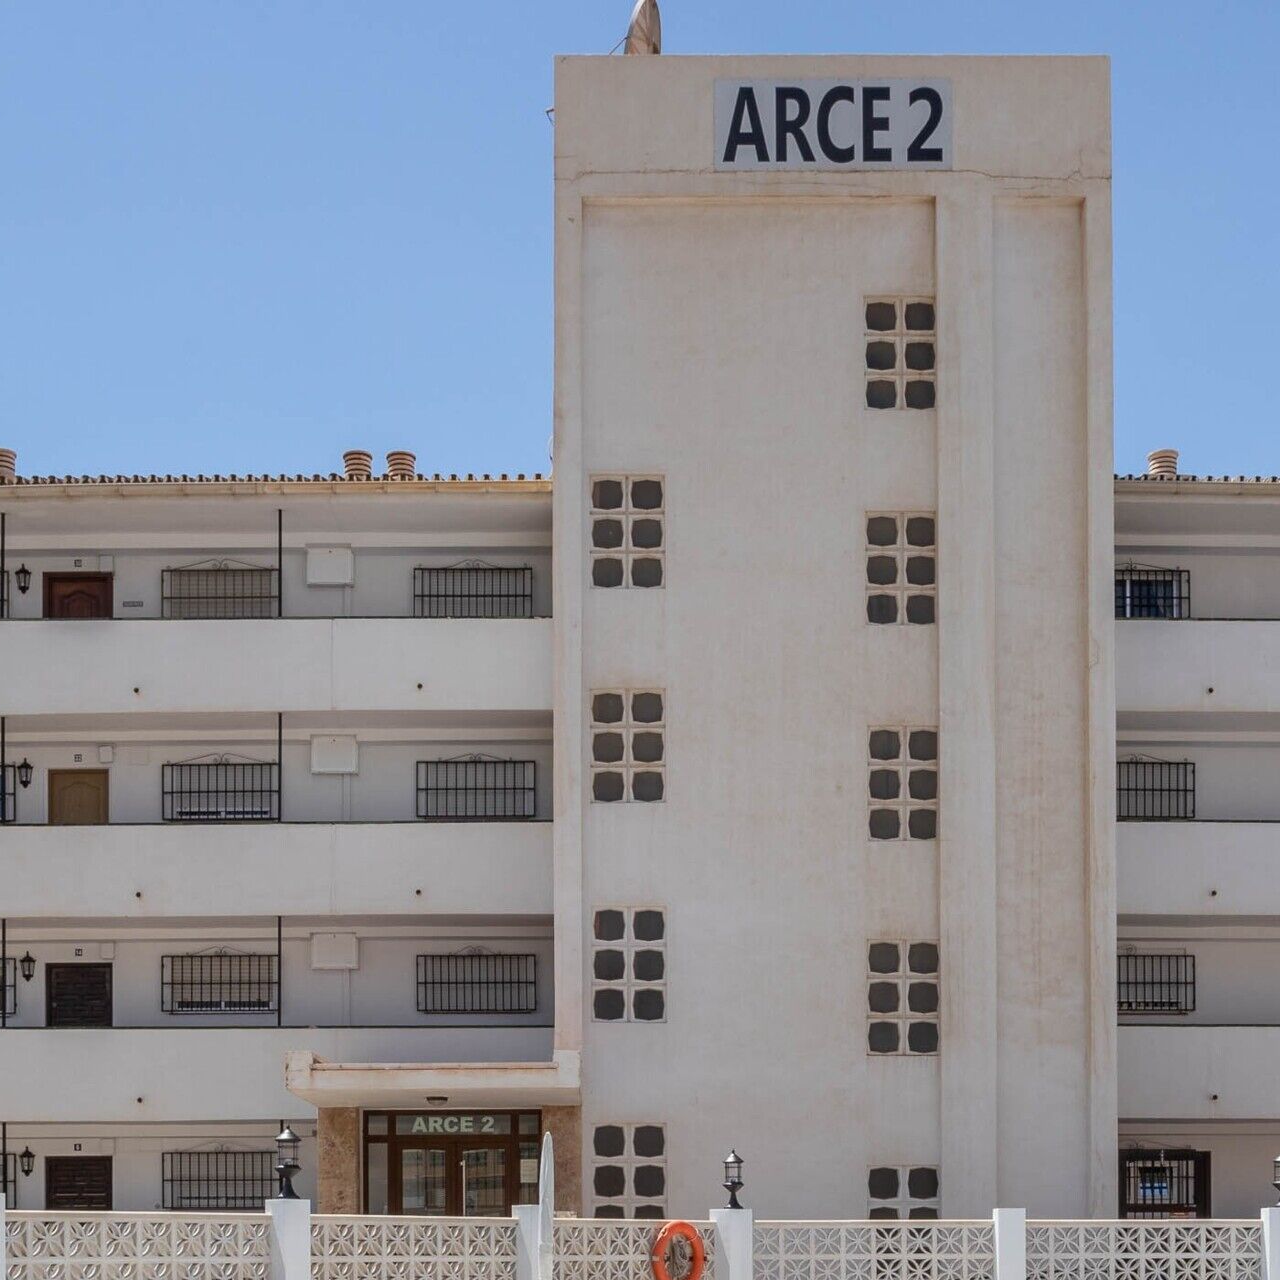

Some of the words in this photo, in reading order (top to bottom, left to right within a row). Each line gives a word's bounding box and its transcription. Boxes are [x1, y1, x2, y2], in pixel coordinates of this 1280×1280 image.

[723, 86, 892, 163] ARCE
[907, 87, 943, 162] 2
[412, 1116, 473, 1133] ARCE
[481, 1116, 495, 1132] 2
